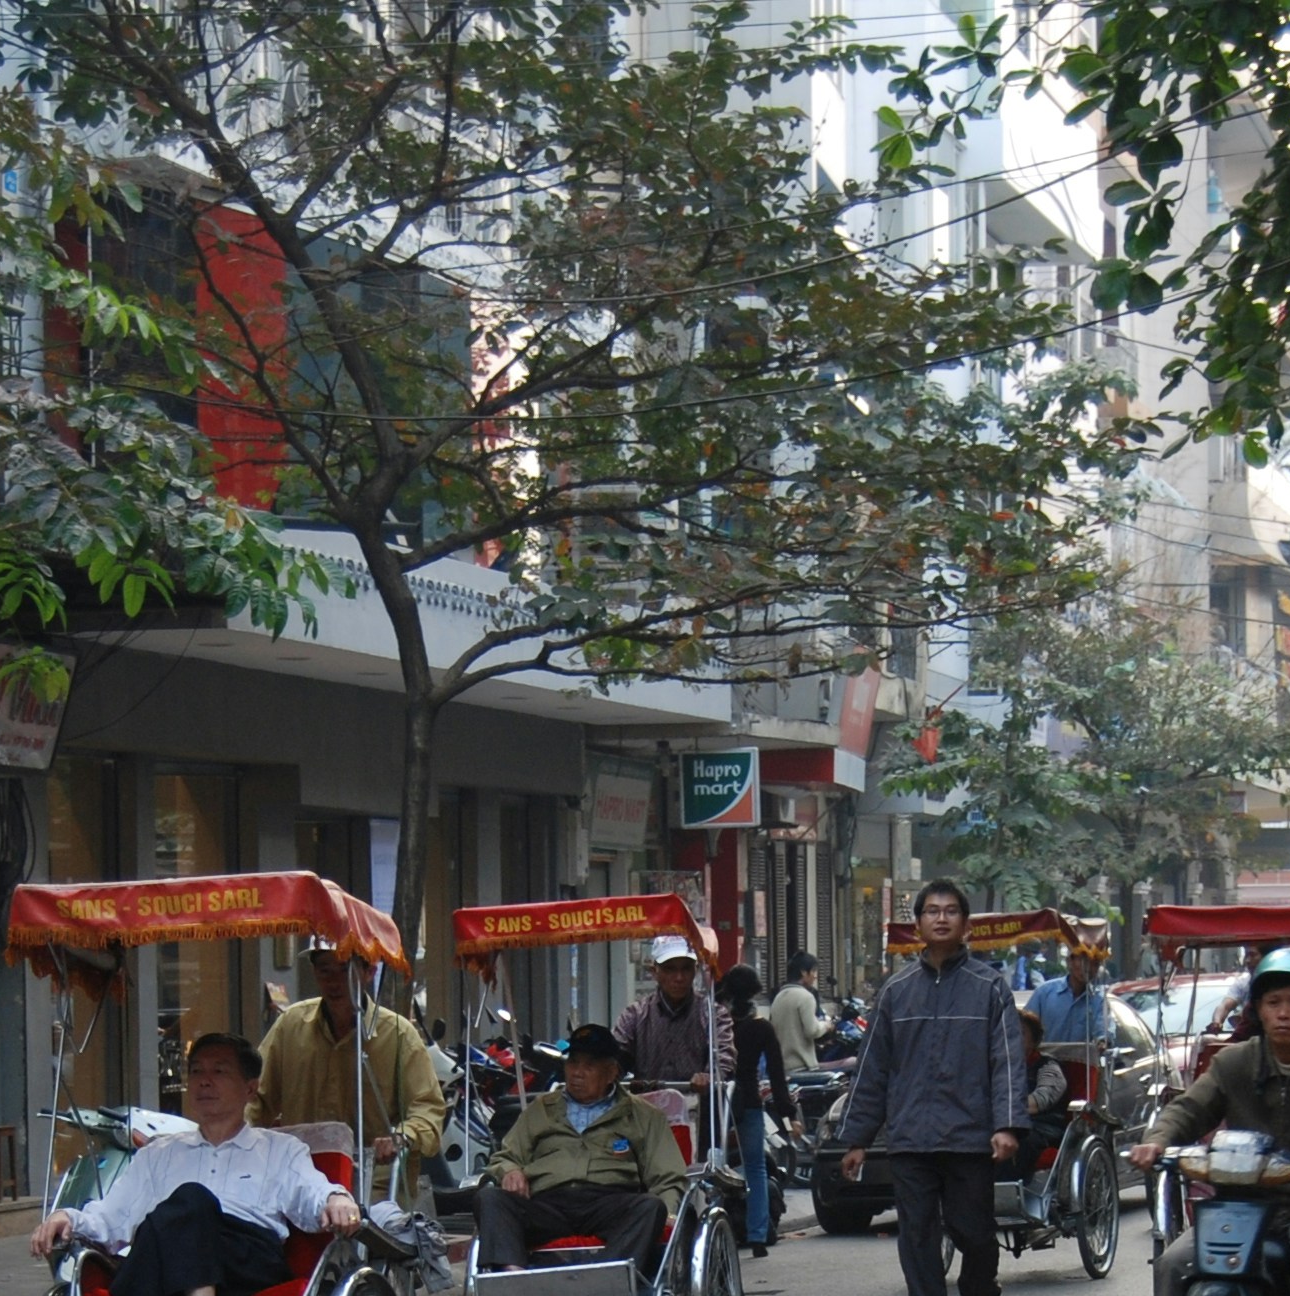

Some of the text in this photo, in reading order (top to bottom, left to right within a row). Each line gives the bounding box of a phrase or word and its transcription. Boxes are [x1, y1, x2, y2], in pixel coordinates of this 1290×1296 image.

[693, 760, 741, 781] Hapro
[694, 782, 742, 795] mart
[56, 898, 117, 920] SANS
[137, 892, 202, 917] SOUCI
[208, 887, 264, 912] SARL
[484, 915, 532, 933] SANS
